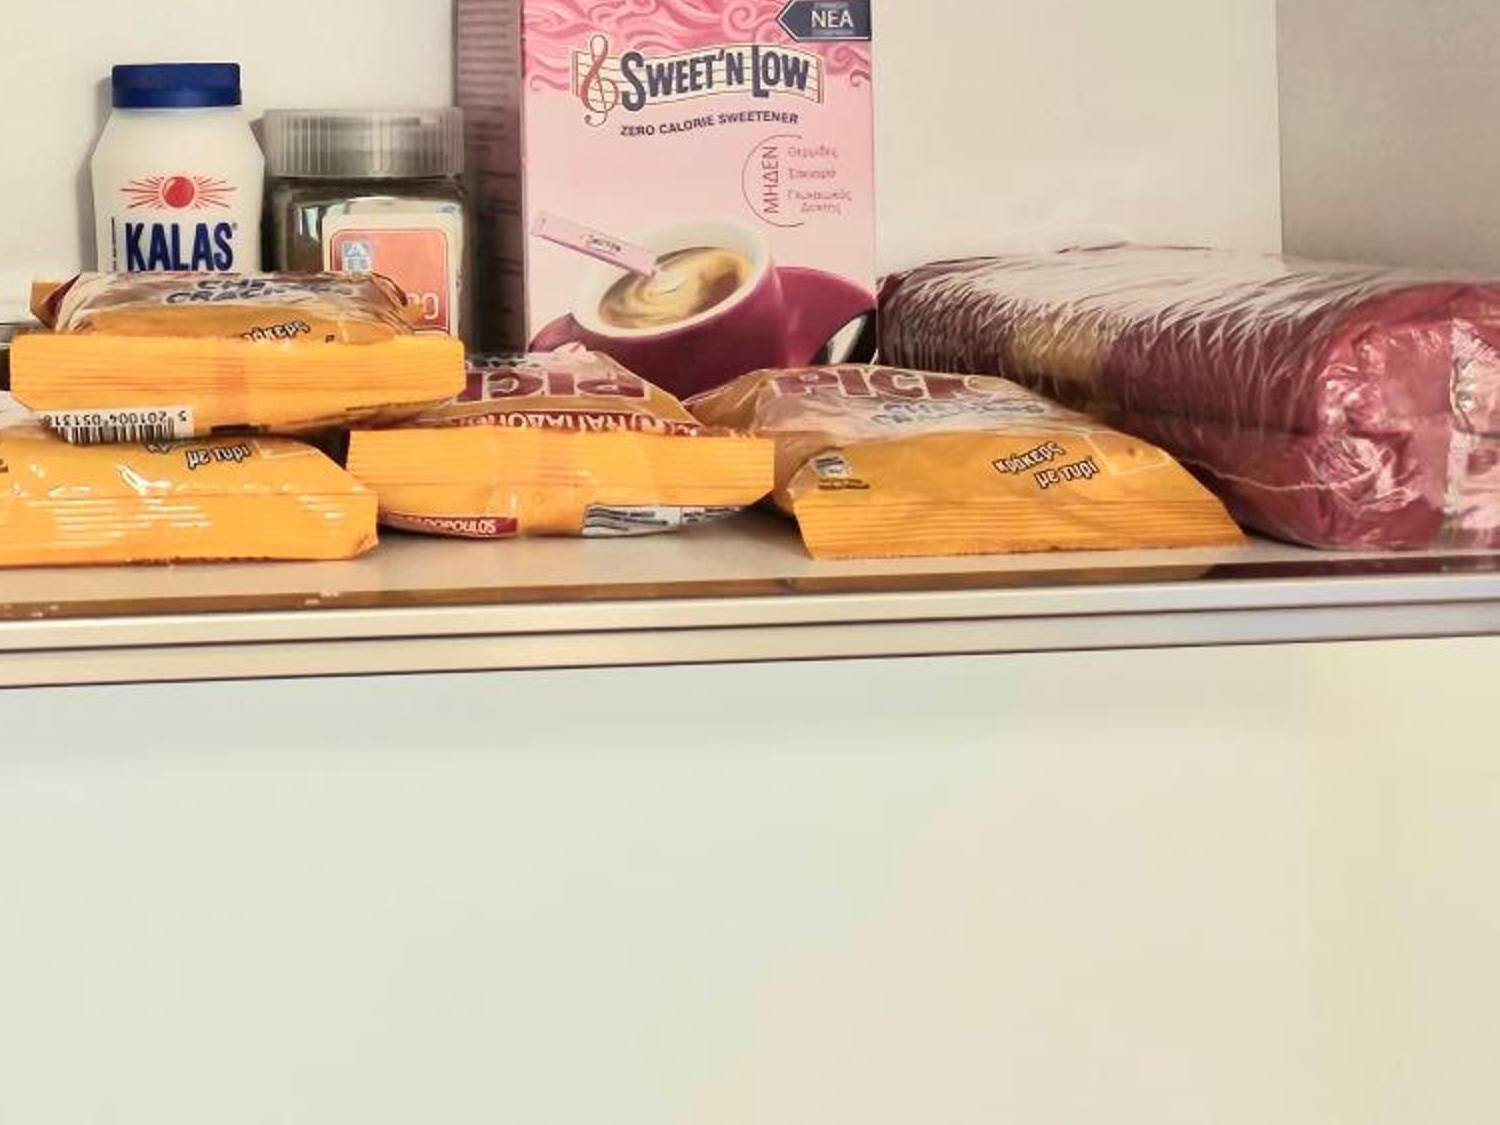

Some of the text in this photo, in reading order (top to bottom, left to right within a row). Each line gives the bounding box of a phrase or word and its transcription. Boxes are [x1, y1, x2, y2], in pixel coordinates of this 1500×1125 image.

[811, 10, 853, 28] ΝΕΑ
[751, 45, 810, 98] LOW
[620, 110, 799, 137] ZERO CALORIE SWEETENER
[761, 146, 779, 214] ΜΗΔΕΝ
[125, 222, 234, 273] KALAS
[186, 450, 210, 469] με
[1035, 469, 1061, 488] με
